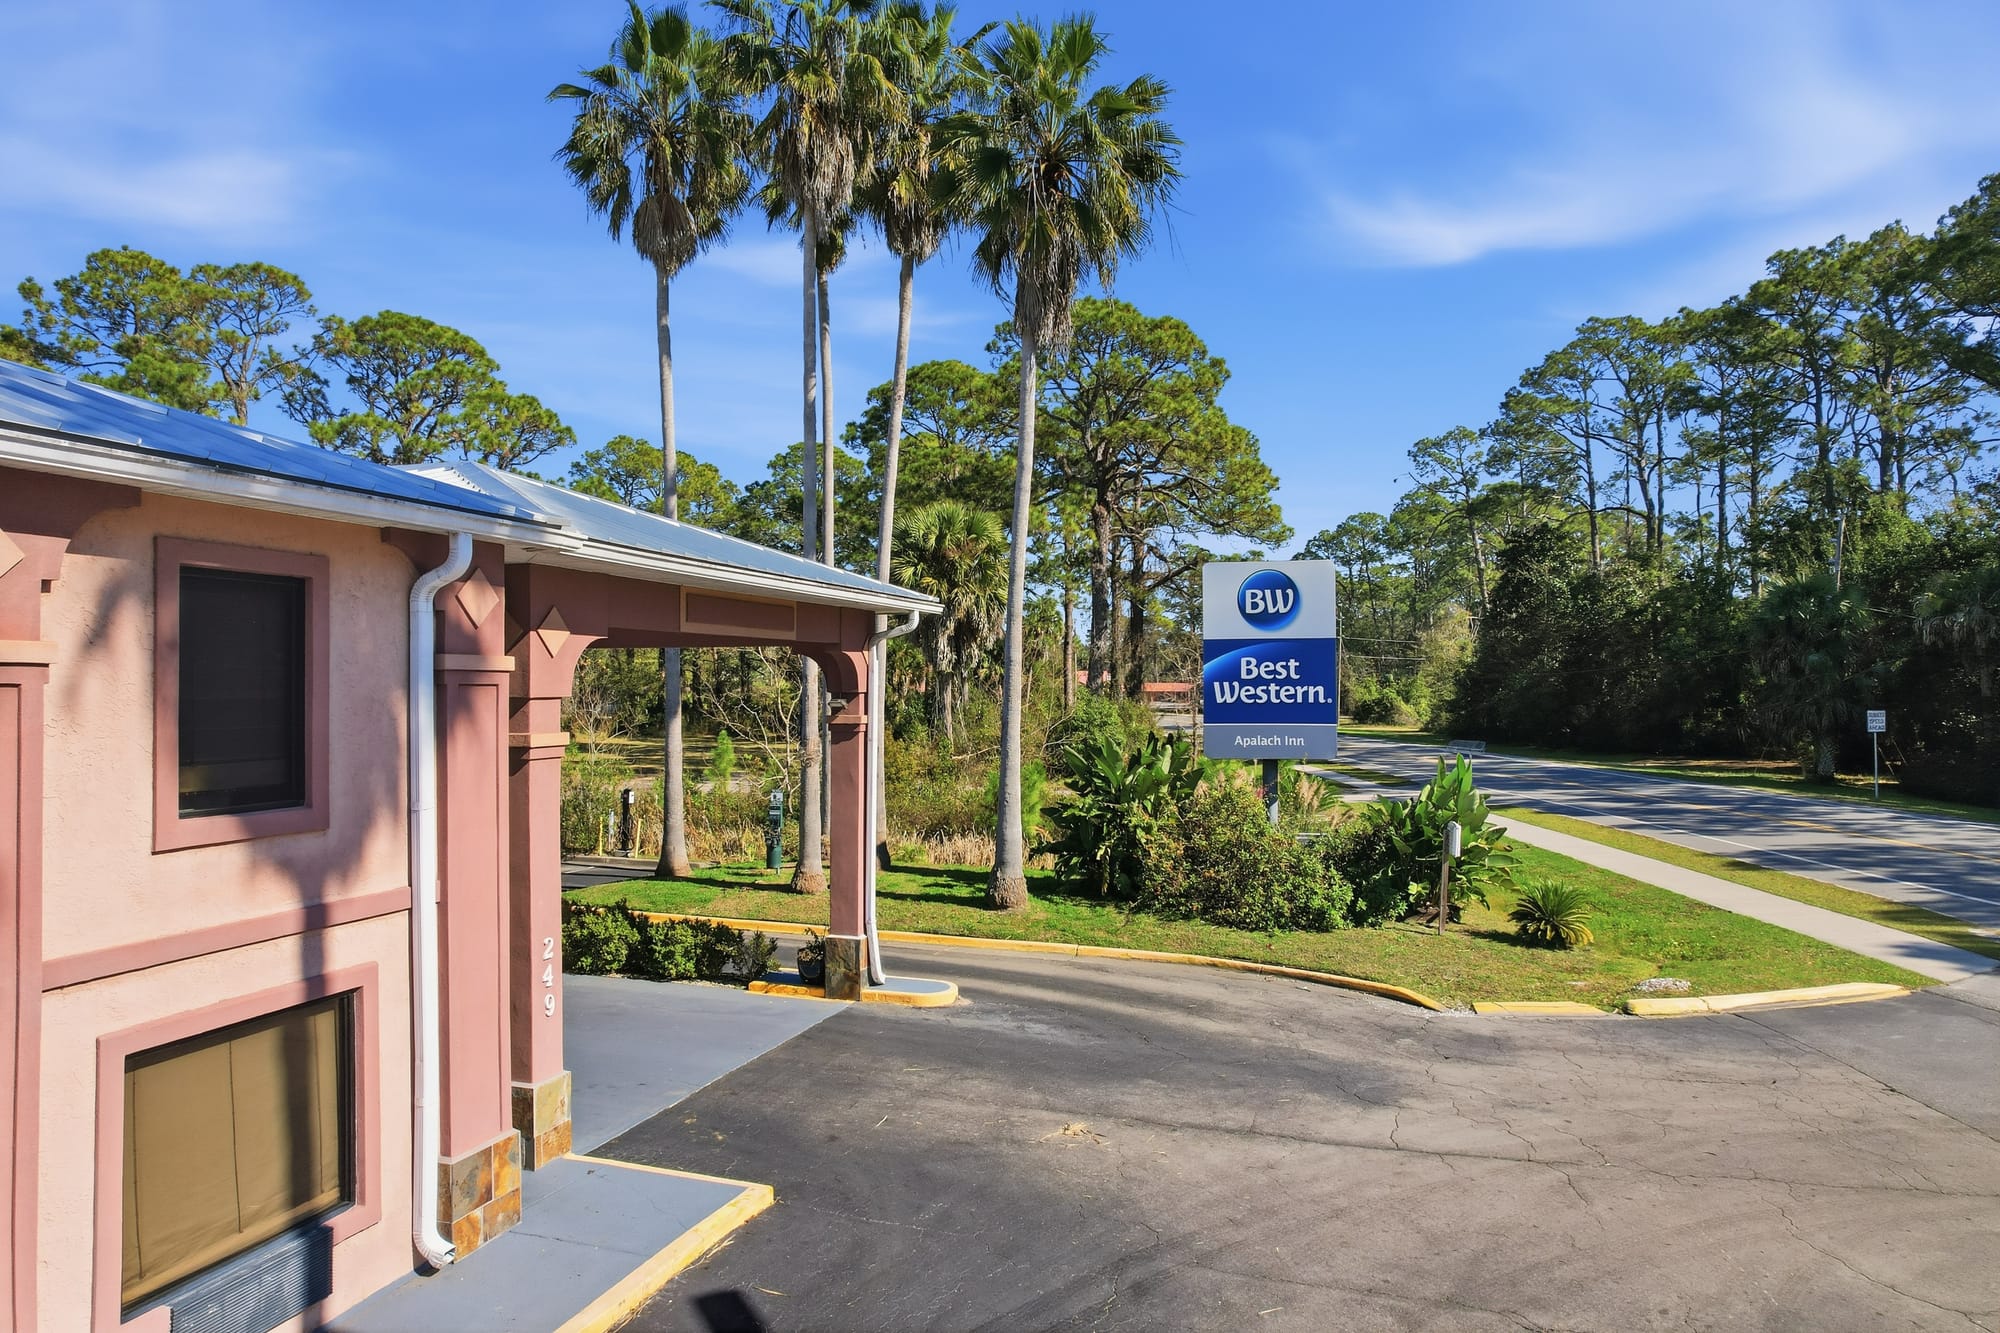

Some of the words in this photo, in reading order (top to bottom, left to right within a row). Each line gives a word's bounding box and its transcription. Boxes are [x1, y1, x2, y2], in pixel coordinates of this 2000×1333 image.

[1245, 588, 1294, 614] BW
[1240, 657, 1300, 680] Best
[1234, 734, 1281, 748] Apalach
[1285, 735, 1304, 746] Inn
[542, 937, 555, 1017] 249
